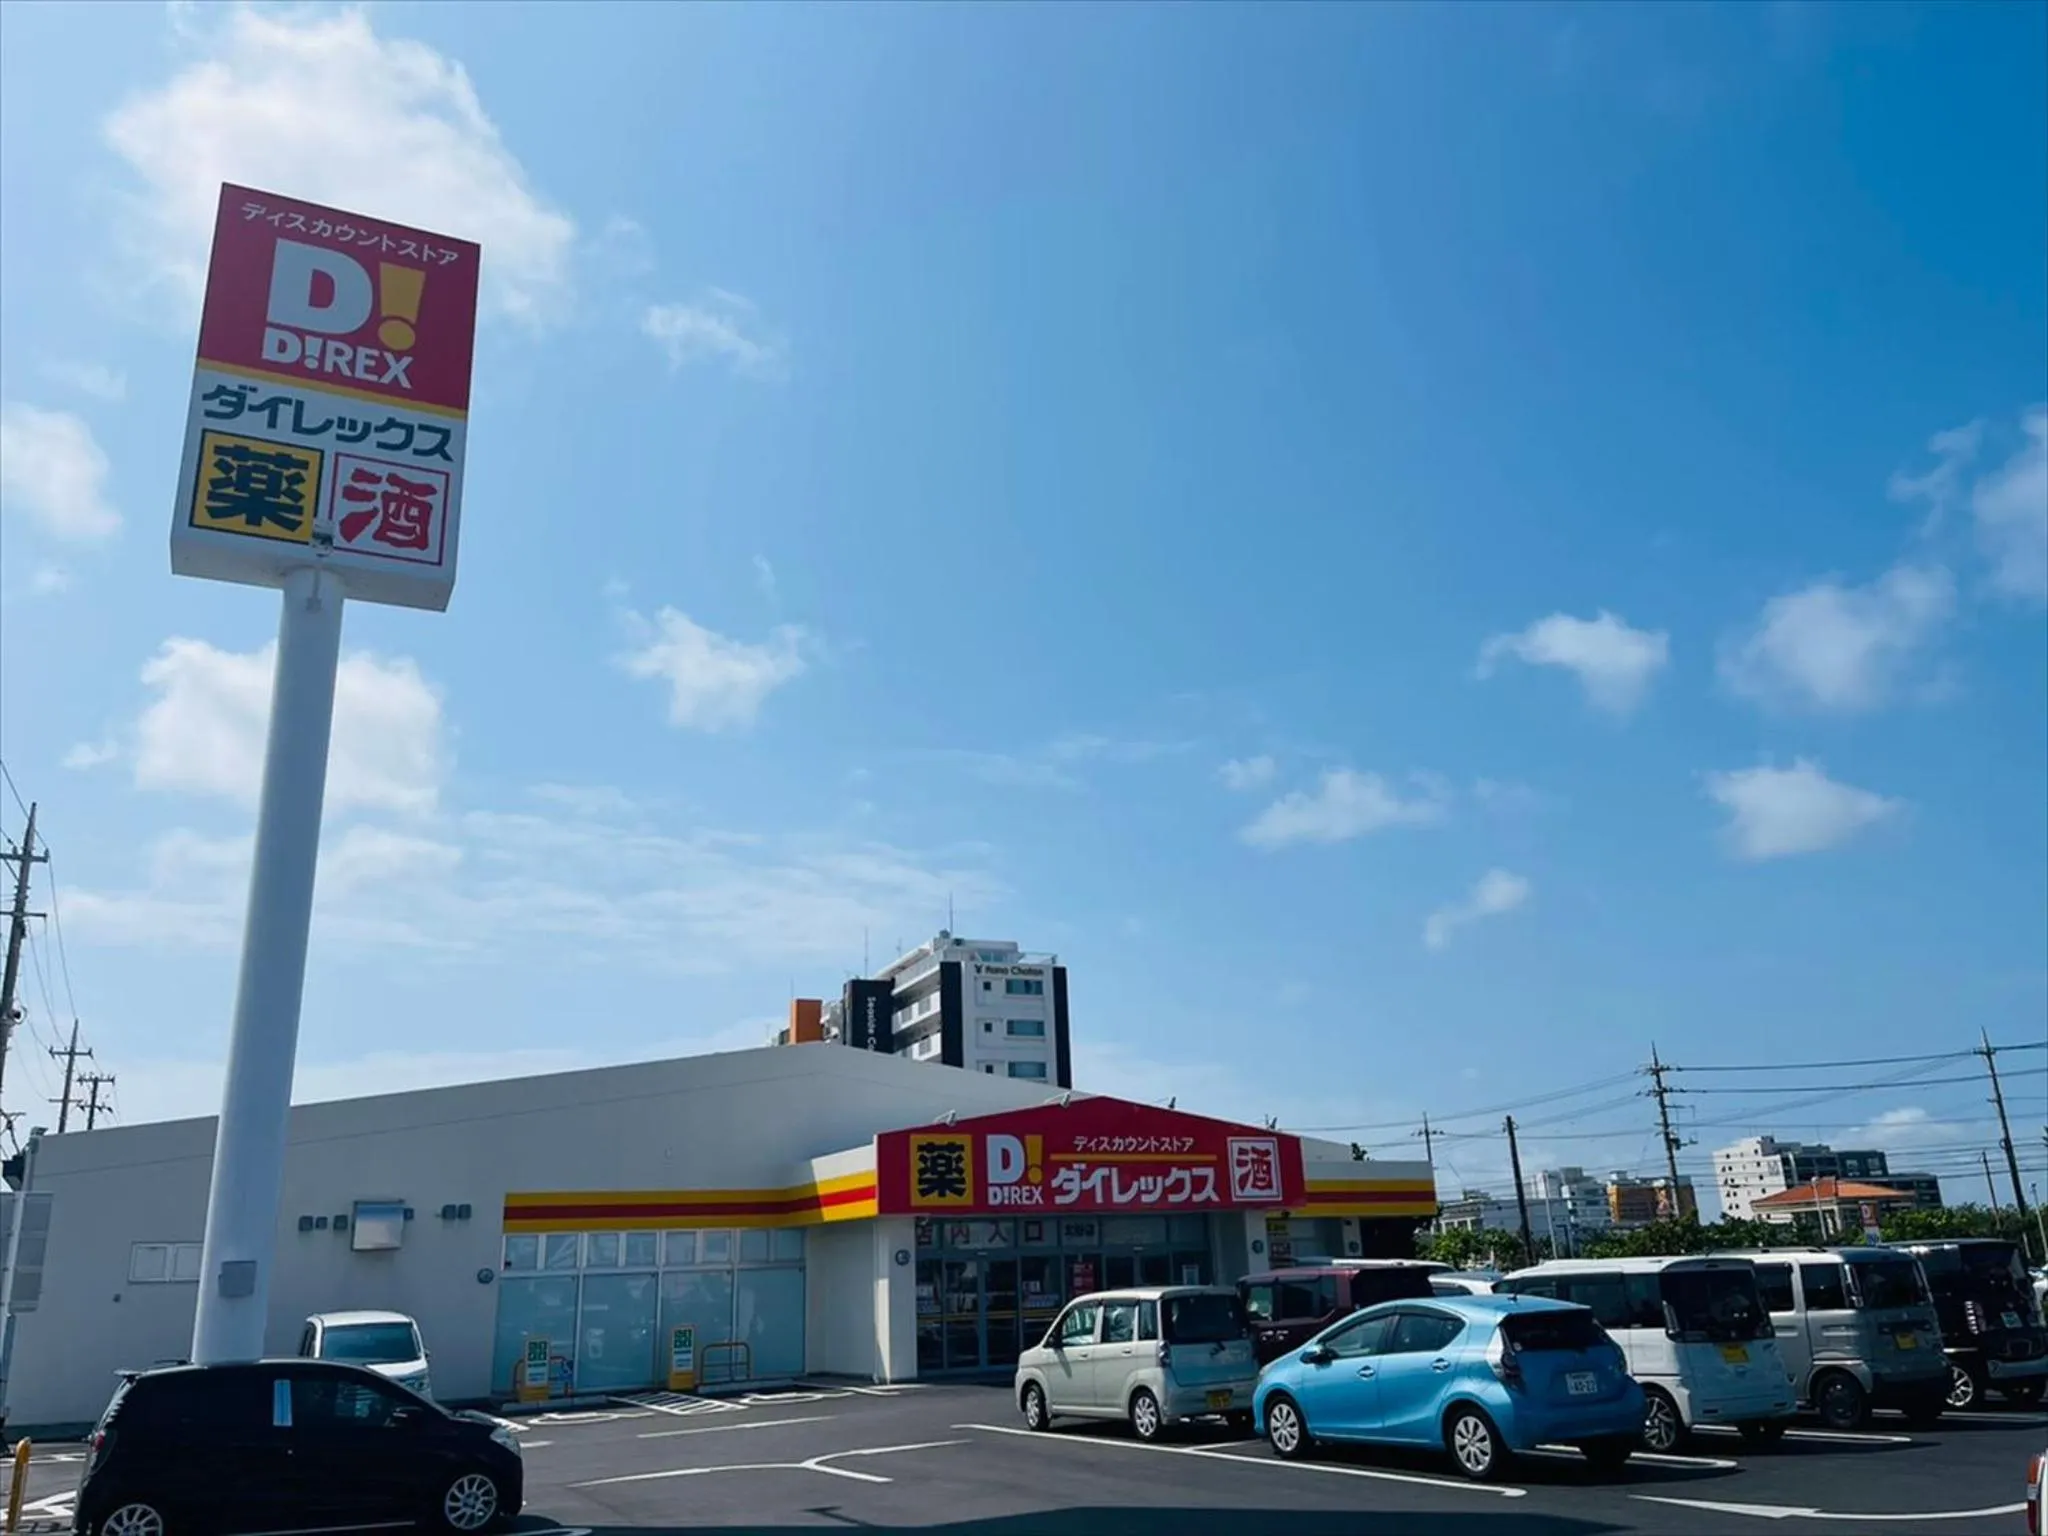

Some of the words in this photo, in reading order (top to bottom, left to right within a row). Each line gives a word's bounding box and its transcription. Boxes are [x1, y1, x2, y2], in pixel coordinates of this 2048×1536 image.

[241, 201, 459, 266] ディスカウントストア
[202, 384, 454, 461] ダイレックス
[205, 444, 309, 532] 薬
[338, 466, 438, 551] 酒
[917, 1141, 967, 1198] 薬
[1073, 1136, 1195, 1152] ディスカウントストア
[1232, 1146, 1272, 1193] 酒
[1051, 1163, 1221, 1204] ダイレックス
